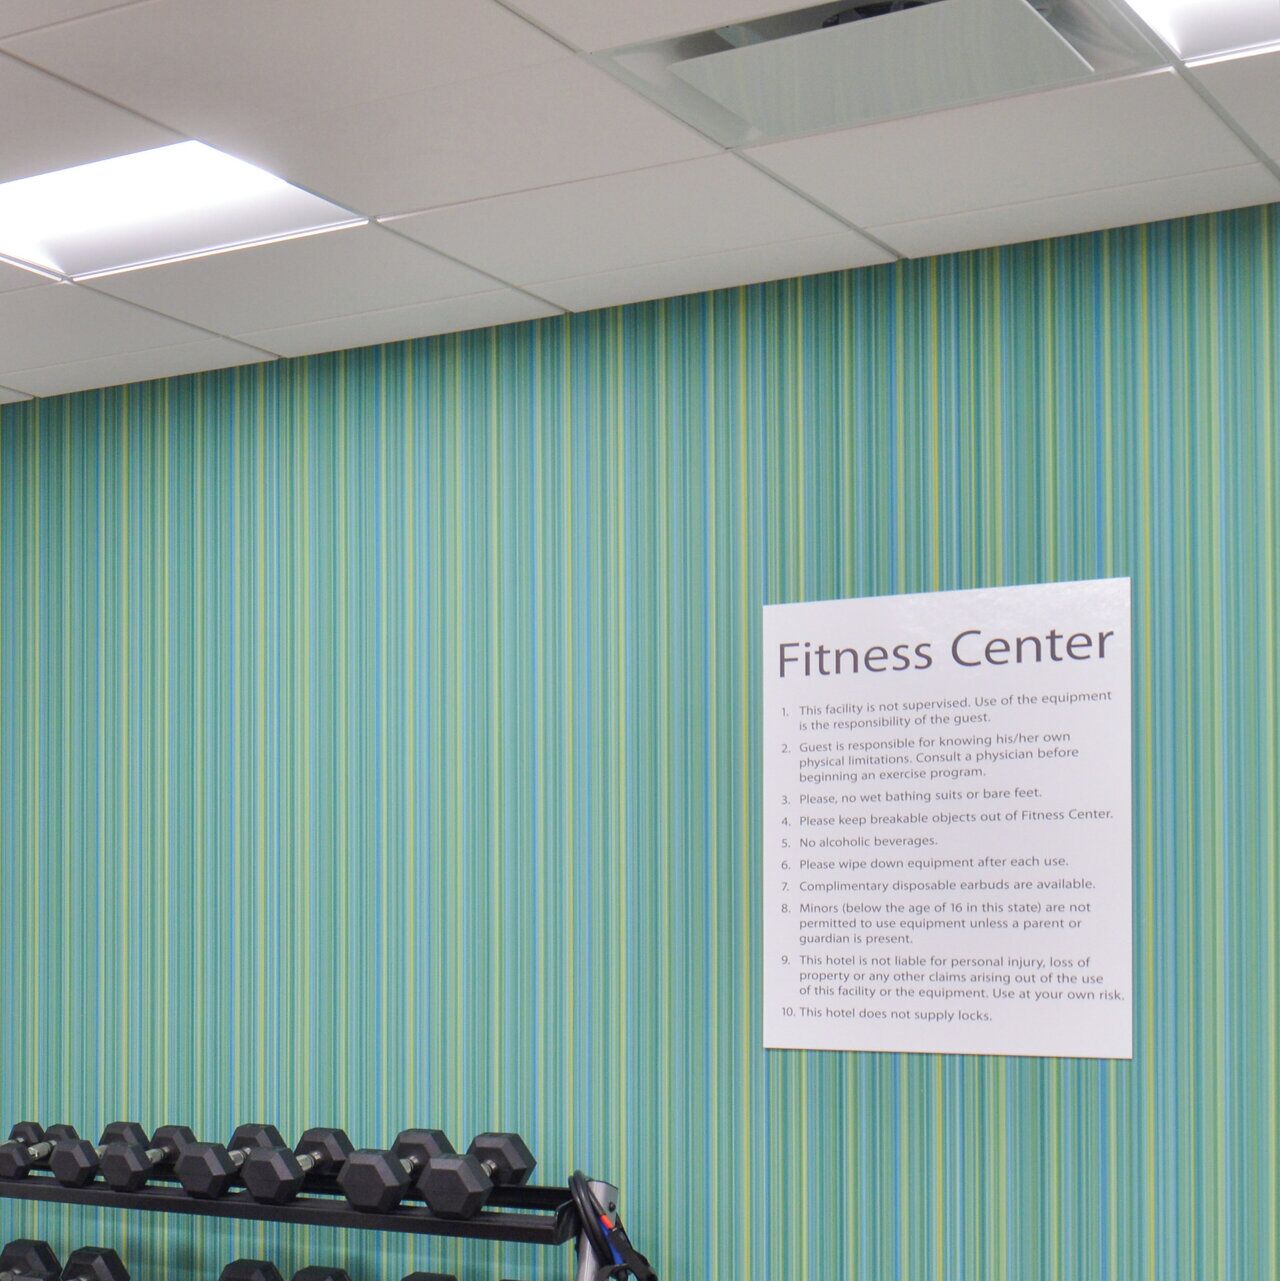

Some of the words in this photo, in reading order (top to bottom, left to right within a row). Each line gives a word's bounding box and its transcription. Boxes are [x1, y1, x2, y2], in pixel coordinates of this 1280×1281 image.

[778, 640, 933, 678] Fitness
[951, 629, 1114, 668] Center
[782, 707, 788, 717] 1.
[799, 705, 822, 715] This
[826, 703, 863, 715] facility
[867, 703, 875, 712] is
[879, 702, 899, 711] not
[902, 697, 970, 711] supervised.
[975, 696, 997, 707] Use
[1001, 694, 1014, 705] of
[1017, 694, 1037, 704] the
[1042, 691, 1112, 705] equipment
[800, 721, 807, 731] is
[811, 720, 829, 730] the
[834, 716, 910, 731] responsibility
[915, 714, 927, 725] of
[930, 714, 950, 724] the
[954, 713, 991, 726] guest.
[782, 744, 791, 753] 2.
[800, 742, 832, 752] Guest
[836, 741, 844, 751] is
[848, 738, 915, 752] responsible
[919, 737, 935, 747] for
[939, 735, 991, 747] knowing
[997, 733, 1039, 744] his/her
[1042, 732, 1070, 742] own
[800, 756, 844, 770] physical
[849, 755, 912, 765] limitations.
[916, 751, 961, 763] Consult
[965, 753, 971, 761] a
[976, 749, 1033, 763] physician
[1038, 747, 1079, 758] before
[800, 771, 857, 784] beginning
[861, 772, 875, 780] an
[880, 769, 926, 780] exercise
[931, 768, 986, 780] program.
[781, 795, 790, 805] 3.
[800, 793, 837, 804] Please,
[842, 795, 856, 803] no
[860, 793, 881, 802] wet
[886, 791, 931, 803] bathing
[936, 790, 962, 800] suits
[967, 791, 979, 799] or
[983, 788, 1010, 799] bare
[1015, 787, 1042, 798] feet.
[782, 817, 791, 827] 4.
[800, 816, 835, 826] Please
[839, 815, 866, 827] keep
[871, 813, 928, 824] breakable
[932, 812, 976, 825] objects
[980, 812, 1001, 822] out
[1005, 810, 1018, 821] of
[1022, 810, 1064, 820] Fitness
[1069, 808, 1113, 820] Center.
[782, 838, 790, 848] 5.
[800, 838, 816, 847] No
[819, 836, 870, 847] alcoholic
[874, 836, 938, 848] beverages.
[781, 860, 791, 870] 6.
[800, 859, 835, 870] Please
[839, 859, 867, 871] wipe
[870, 858, 903, 869] down
[908, 858, 975, 870] equipment
[978, 856, 1007, 867] after
[1011, 856, 1039, 867] each
[1044, 857, 1068, 866] use.
[782, 882, 789, 891] 7.
[800, 881, 889, 893] Complimentary
[892, 880, 956, 893] disposable
[960, 879, 1009, 890] earbuds
[1037, 878, 1095, 889] available.
[781, 904, 791, 913] 8.
[800, 903, 838, 913] Minors
[843, 902, 881, 914] (below
[886, 902, 905, 913] the
[909, 905, 930, 915] age
[934, 902, 947, 912] of
[951, 903, 962, 913] 16
[967, 903, 977, 912] in
[982, 902, 1003, 912] this
[1008, 902, 1041, 913] state)
[1046, 904, 1065, 912] are
[1070, 903, 1091, 912] not
[800, 918, 856, 930] permitted
[861, 920, 872, 928] to
[876, 920, 896, 928] use
[900, 918, 966, 931] equipment
[970, 917, 1008, 928] unless
[1012, 920, 1019, 928] a
[1024, 919, 1064, 931] parent
[1069, 920, 1082, 928] or
[799, 933, 849, 946] guardian
[854, 933, 863, 943] is
[866, 935, 912, 946] present.
[781, 955, 790, 965] 9.
[800, 955, 822, 965] This
[826, 955, 855, 965] hotel
[859, 956, 867, 966] is
[872, 957, 891, 966] not
[895, 955, 926, 966] liable
[930, 955, 947, 966] for
[951, 956, 1003, 968] personal
[1008, 957, 1045, 970] injury,
[1050, 957, 1073, 968] loss
[1077, 957, 1090, 968] of
[800, 971, 850, 983] property
[853, 973, 865, 981] or
[869, 973, 889, 983] any
[893, 971, 924, 982] other
[929, 971, 966, 982] claims
[970, 972, 1010, 985] arising
[1015, 974, 1036, 983] out
[1040, 972, 1053, 983] of
[1057, 973, 1077, 984] the
[1082, 976, 1103, 984] use
[799, 985, 811, 995] of
[814, 985, 834, 995] this
[838, 985, 876, 998] facility
[896, 986, 915, 997] the
[919, 988, 988, 1000] equipment.
[993, 987, 1015, 999] Use
[1019, 990, 1031, 999] at
[1035, 991, 1063, 1002] your
[1067, 990, 1095, 1000] own
[1100, 989, 1124, 1000] risk.
[782, 1007, 795, 1016] 10.
[800, 1007, 822, 1017] This
[826, 1007, 855, 1018] hotel
[859, 1008, 887, 1019] does
[891, 1010, 911, 1019] not
[915, 1010, 954, 1023] supply
[959, 1010, 992, 1021] locks.
